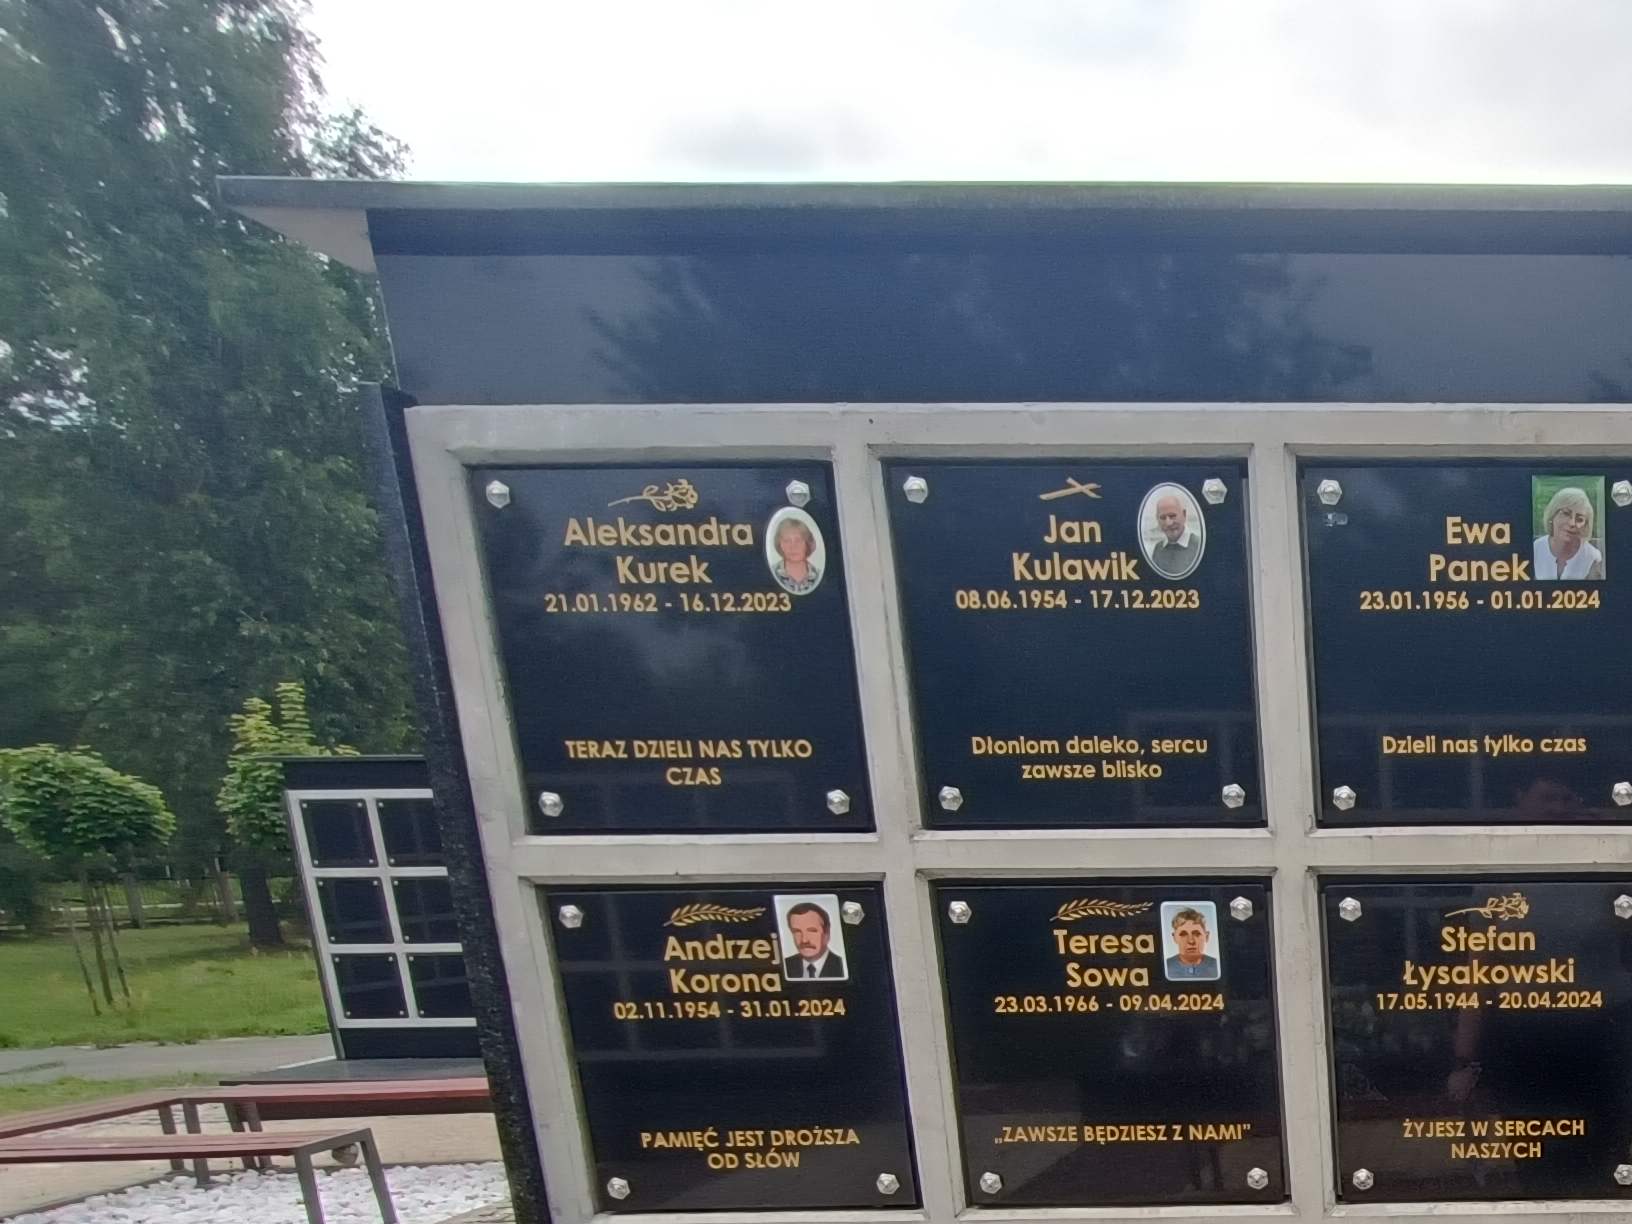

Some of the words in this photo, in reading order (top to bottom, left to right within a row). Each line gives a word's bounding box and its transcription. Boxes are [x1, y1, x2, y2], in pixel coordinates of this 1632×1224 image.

[564, 516, 754, 547] Aleksandra
[1043, 514, 1102, 544] Jan
[1446, 516, 1511, 545] Ewa
[615, 554, 713, 584] Kurek
[1012, 551, 1141, 581] Kulawik
[1429, 552, 1531, 582] Panek
[544, 592, 658, 613] 21.01.1962
[680, 592, 792, 614] 16.12.2023
[955, 589, 1068, 610] 08.06.1954
[1089, 589, 1200, 609] 17.12.2023
[1359, 590, 1470, 610] 23.01.1956
[1490, 589, 1601, 610] 01.01.2024
[564, 740, 628, 759] TERAZ
[632, 739, 693, 759] DZIELI
[698, 739, 743, 759] NAS
[746, 739, 813, 758] TYLKO
[971, 735, 1060, 755] Dłoniom
[1065, 735, 1145, 755] daleko,
[1151, 739, 1208, 754] sercu
[1382, 735, 1436, 754] Dzieli
[1442, 739, 1479, 753] nas
[1483, 734, 1534, 757] tylko
[1540, 737, 1587, 753] czas
[665, 767, 722, 786] CZAS
[1021, 764, 1097, 779] zawsze
[1101, 759, 1162, 778] blisko
[663, 933, 782, 965] Andrzej
[1053, 929, 1155, 955] Teresa
[1441, 925, 1536, 952] Stefan
[669, 968, 782, 994] Korona
[1066, 962, 1150, 988] Sowa
[1402, 957, 1575, 992] Łysakowski
[613, 1000, 721, 1020] 02.11.1954
[740, 998, 846, 1018] 31.01.2024
[994, 995, 1100, 1013] 23.03.1966
[1119, 993, 1225, 1012] 09.04.2024
[1376, 991, 1480, 1010] 17.05.1944
[1498, 990, 1603, 1009] 20.04.2024
[640, 1126, 719, 1151] PAMIĘĆ
[724, 1130, 765, 1147] JEST
[769, 1125, 861, 1146] DROŻSZA
[1083, 1124, 1168, 1145] BĘDZIESZ
[1171, 1124, 1184, 1141] Z
[1402, 1118, 1466, 1138] ŻYJESZ
[1470, 1120, 1489, 1137] W
[1493, 1119, 1585, 1137] SERCACH
[707, 1152, 739, 1169] OD
[744, 1147, 801, 1169] SŁÓW
[1451, 1141, 1542, 1159] NASZYCH
